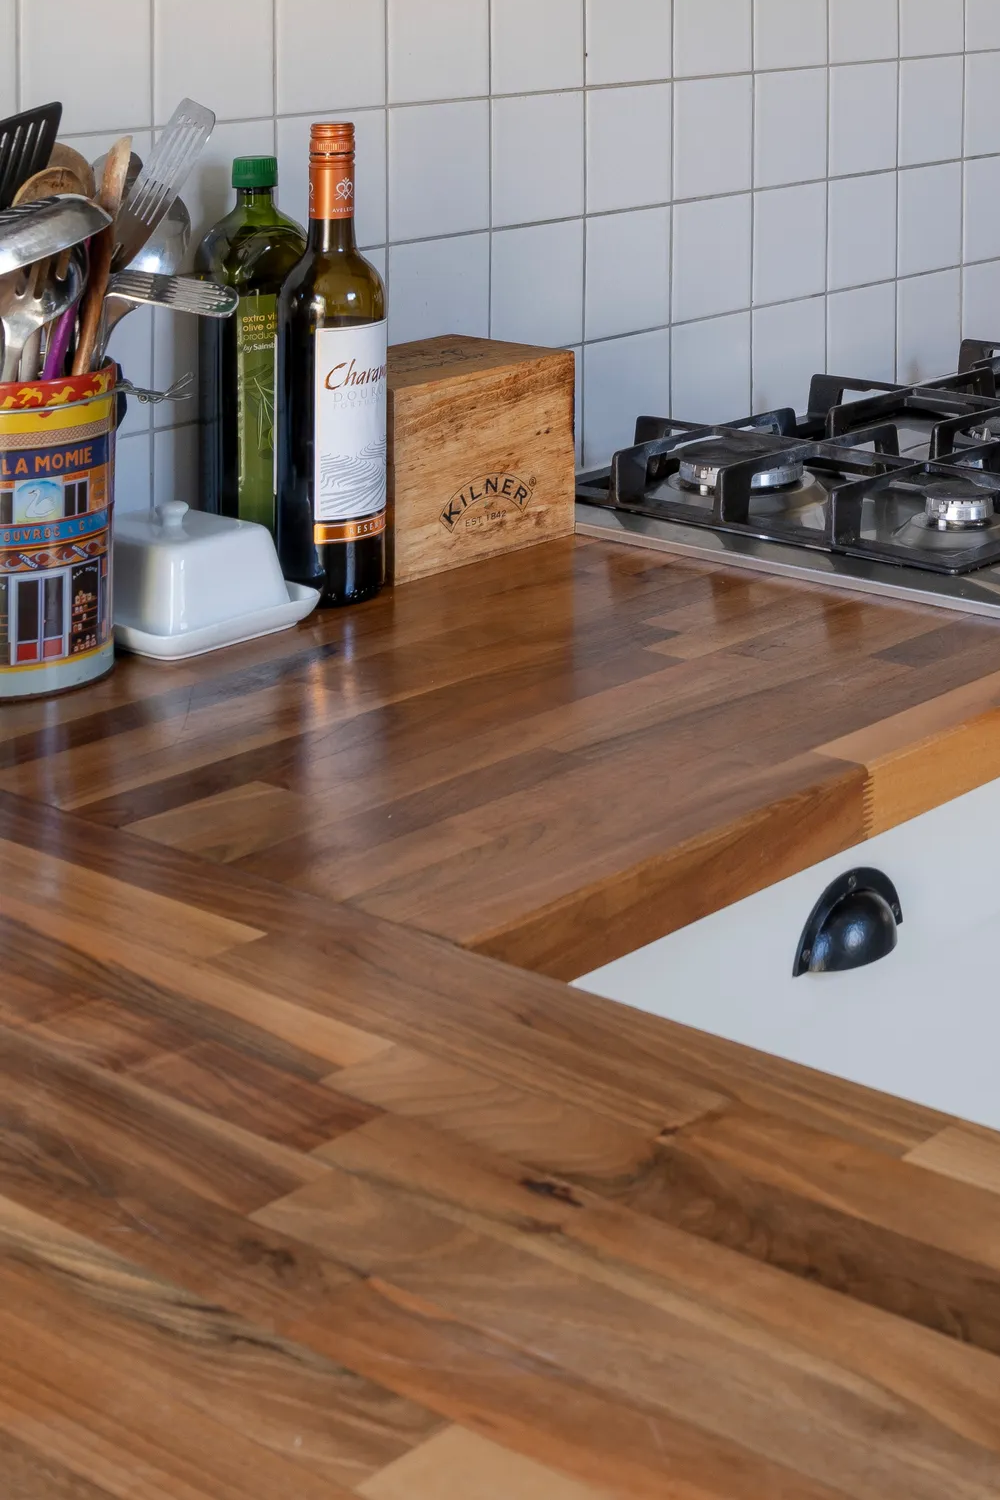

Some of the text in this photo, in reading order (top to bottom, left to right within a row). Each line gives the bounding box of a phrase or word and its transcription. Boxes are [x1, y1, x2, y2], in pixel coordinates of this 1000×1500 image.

[242, 314, 266, 323] extra
[242, 323, 265, 332] olive
[242, 341, 276, 354] by Sainsb
[333, 383, 384, 403] DOURO
[1, 446, 93, 476] LA MOMIE
[442, 476, 528, 525] KILNER
[465, 509, 507, 527] EST 1842
